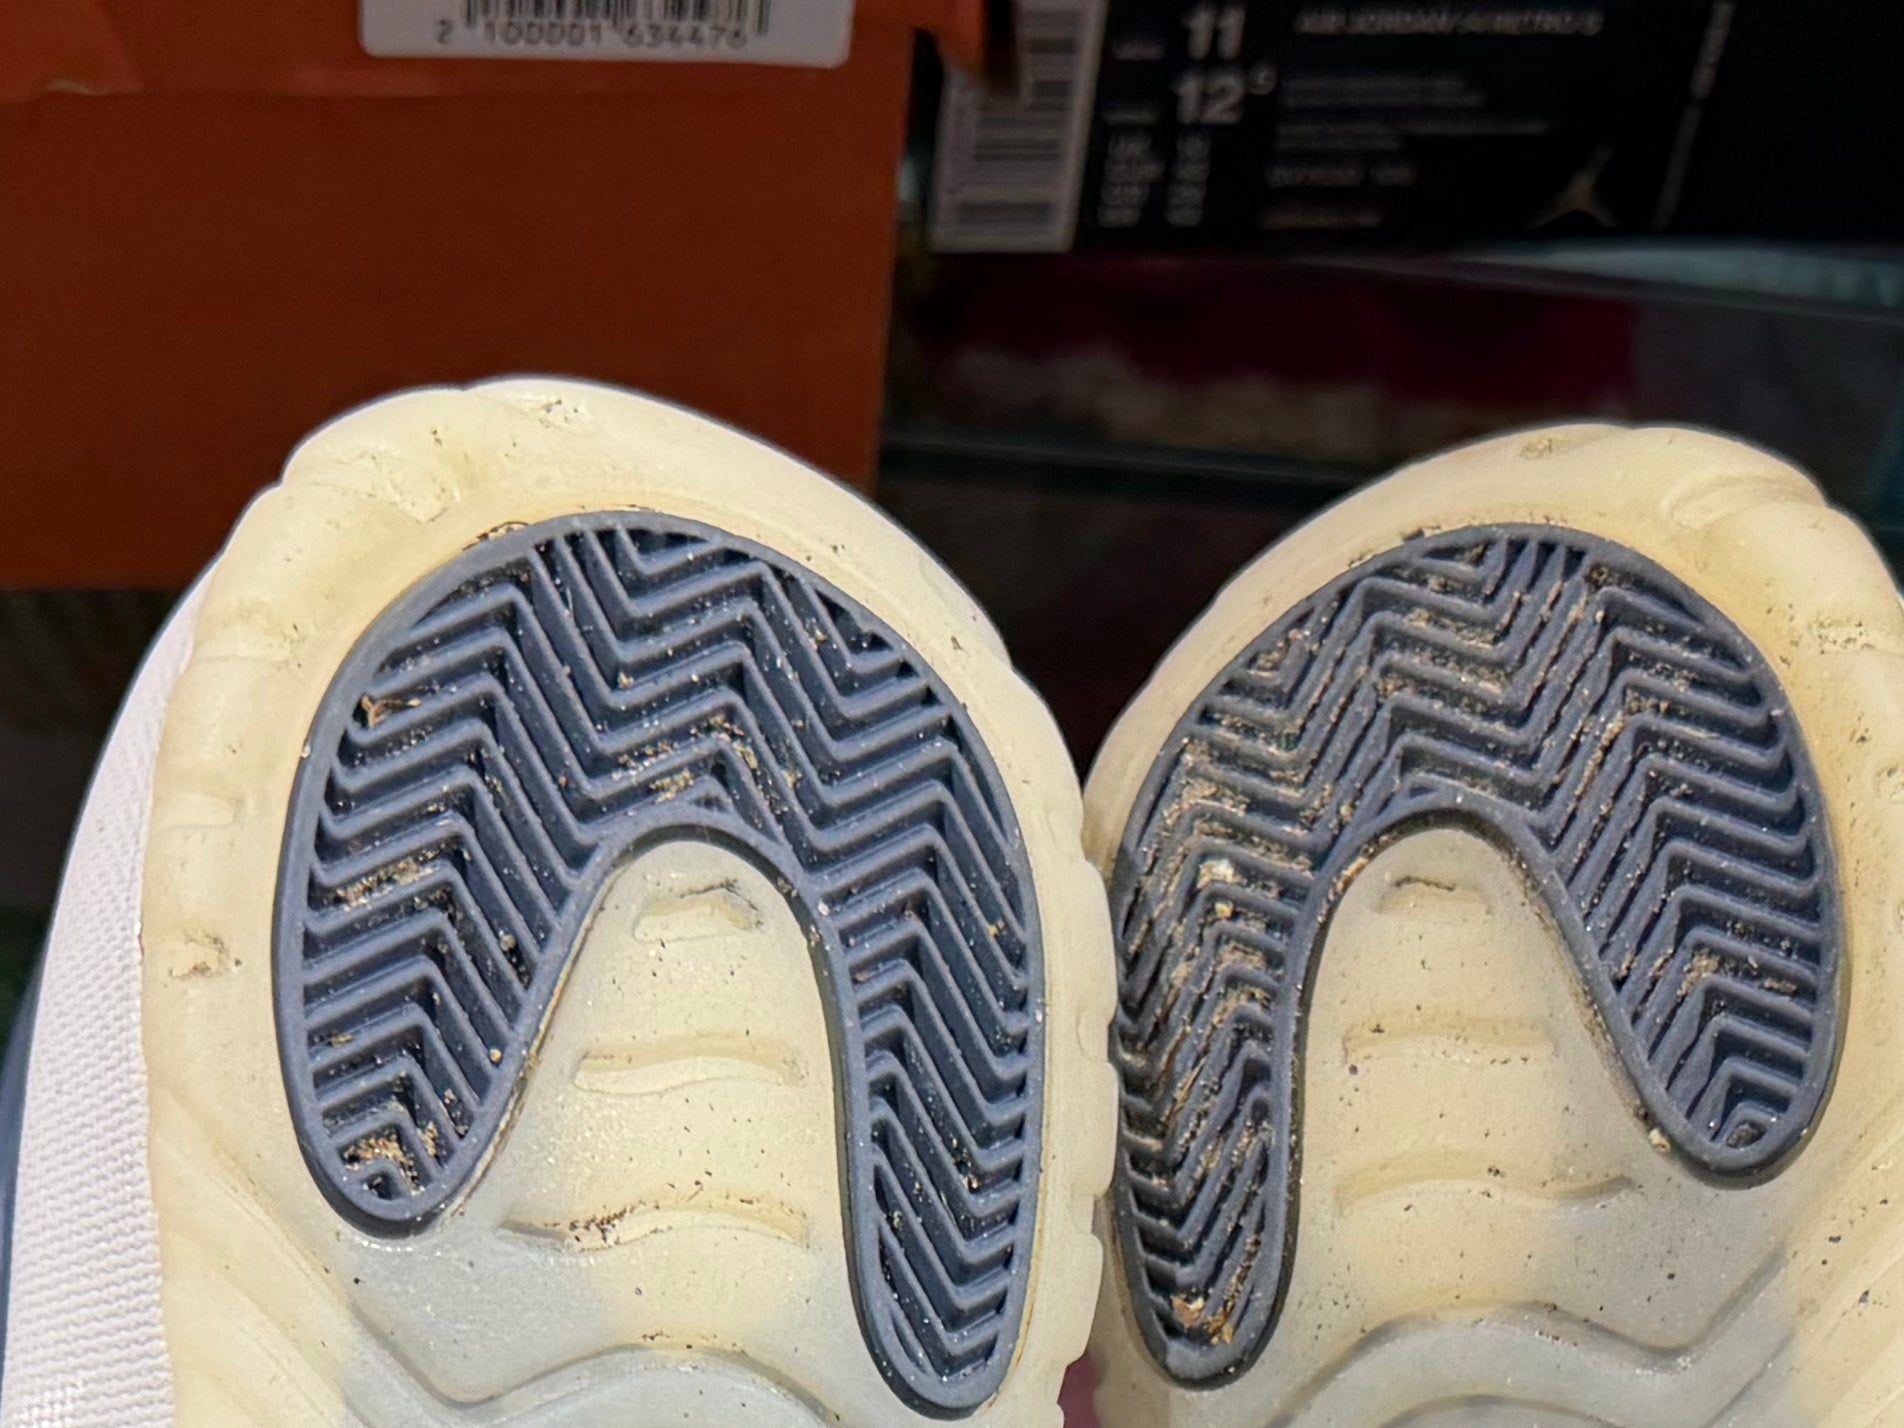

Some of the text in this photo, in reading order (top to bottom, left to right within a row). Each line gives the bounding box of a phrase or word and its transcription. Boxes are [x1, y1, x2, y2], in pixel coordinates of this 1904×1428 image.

[483, 20, 603, 46] 100001
[624, 22, 750, 48] 634476
[1180, 2, 1245, 60] 11
[1170, 66, 1246, 124] 12
